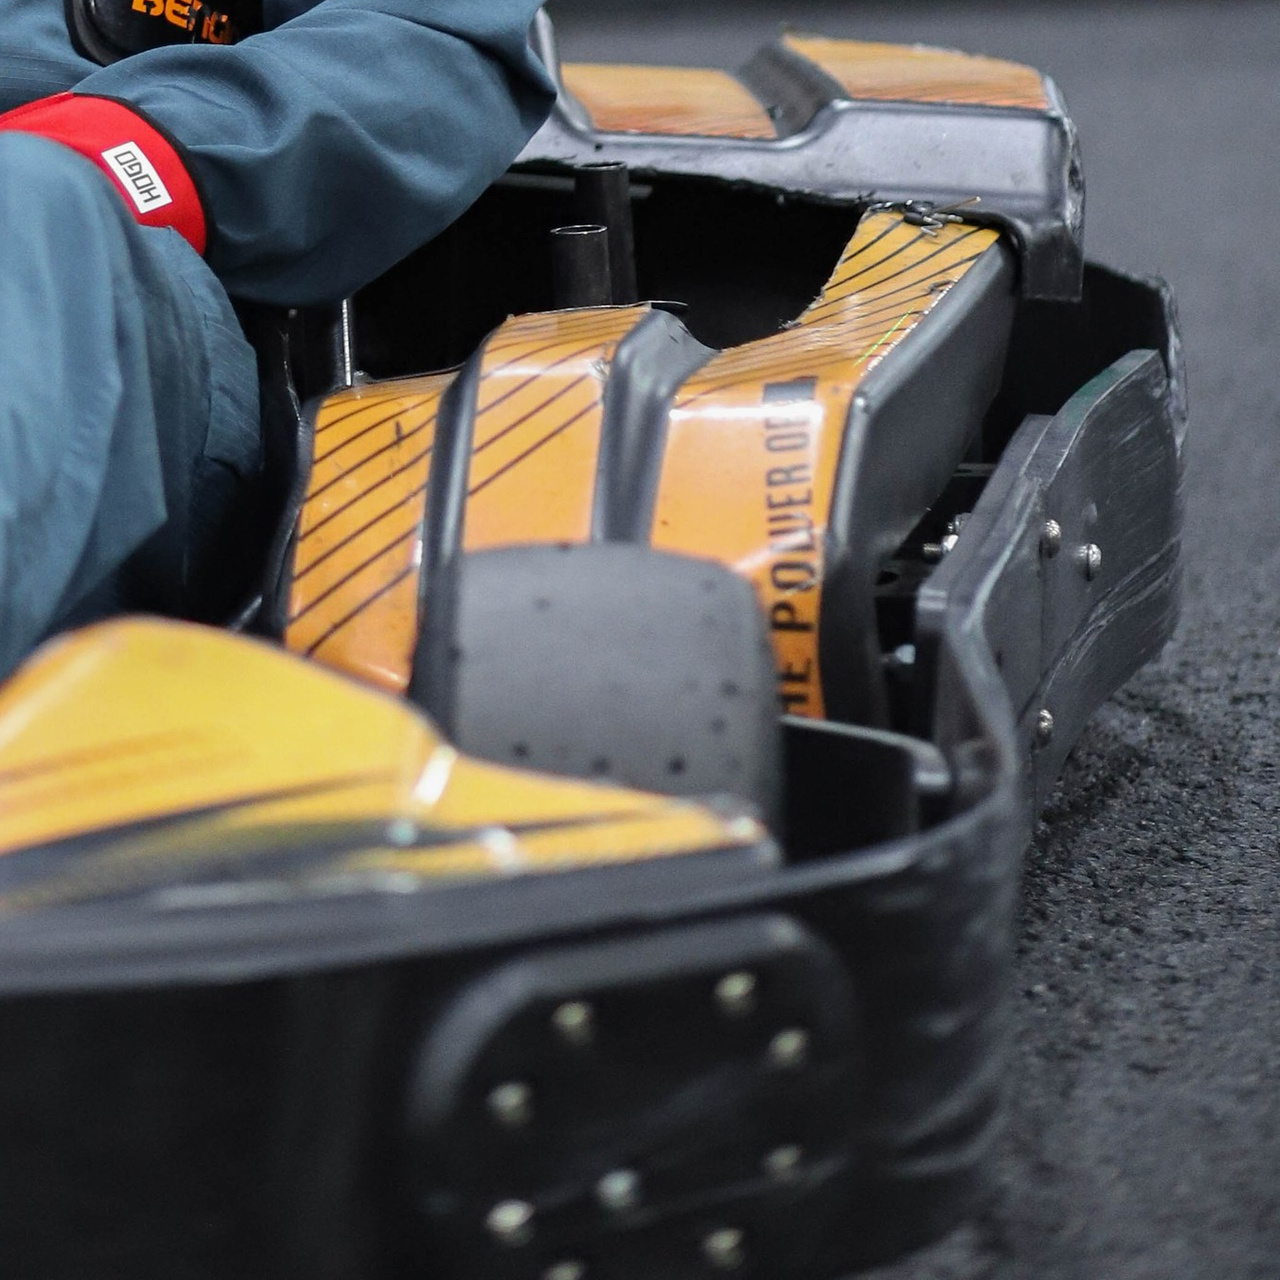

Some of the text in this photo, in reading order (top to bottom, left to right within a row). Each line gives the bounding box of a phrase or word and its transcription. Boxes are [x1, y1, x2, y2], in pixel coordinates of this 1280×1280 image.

[113, 150, 162, 204] HOGO
[765, 462, 818, 632] POWER
[776, 654, 812, 719] HE
